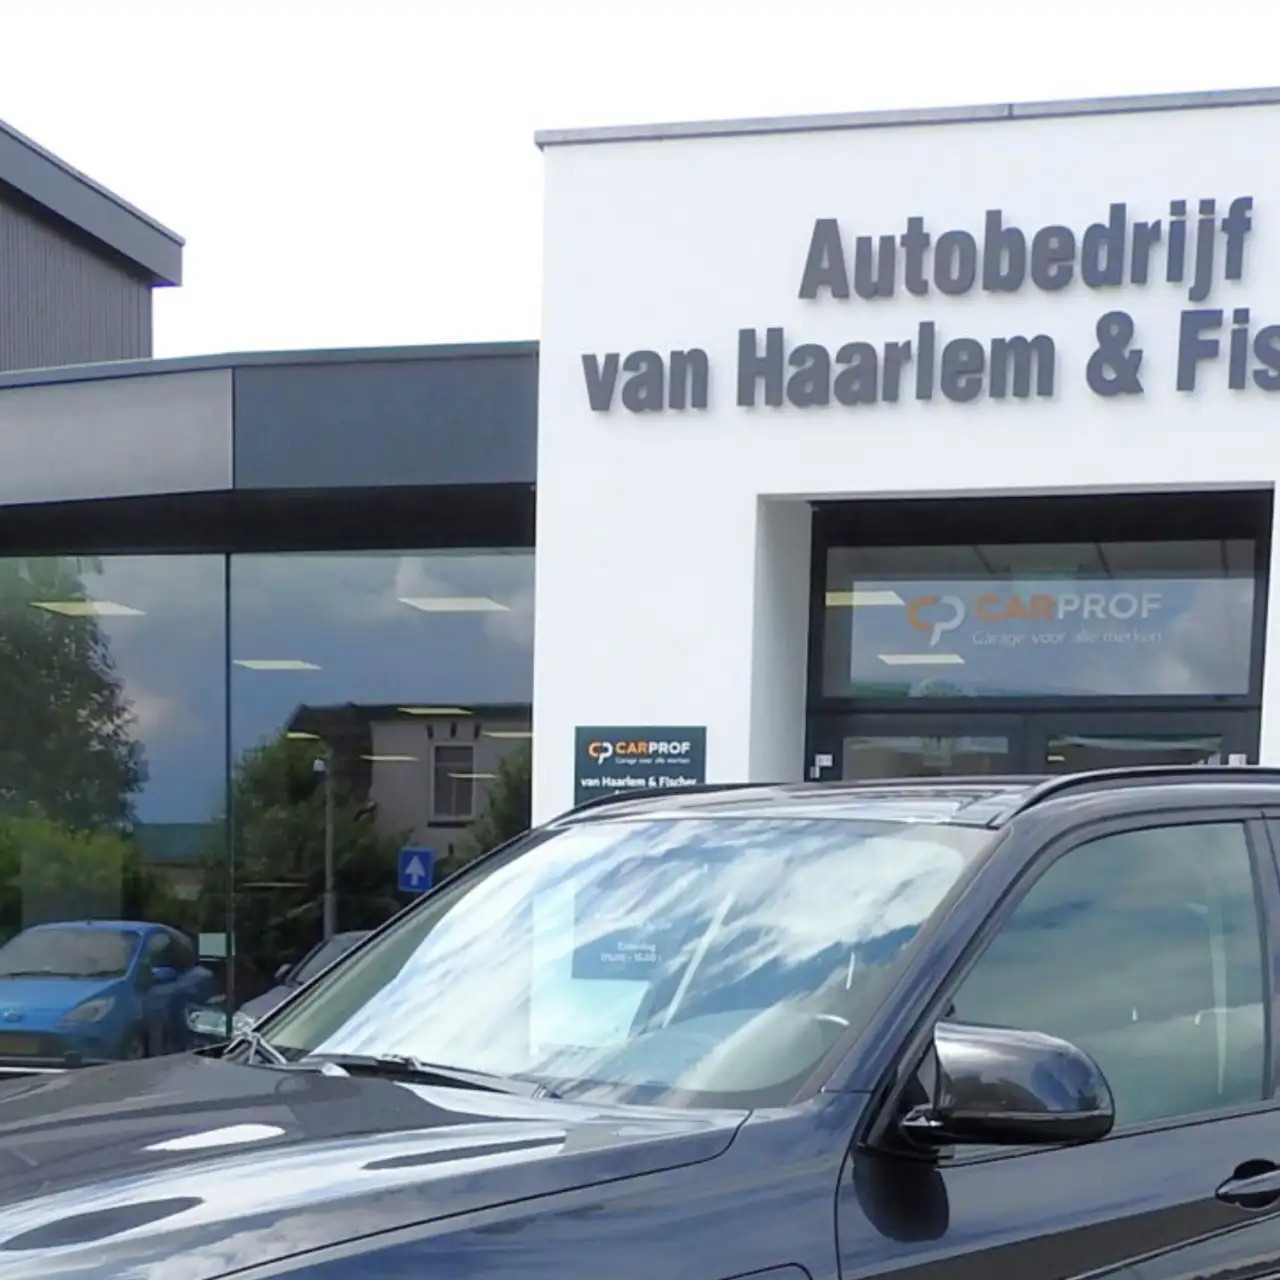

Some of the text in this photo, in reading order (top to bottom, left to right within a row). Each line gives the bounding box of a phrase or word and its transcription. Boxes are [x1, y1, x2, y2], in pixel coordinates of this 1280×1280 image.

[798, 197, 1254, 302] Autobedrijf
[582, 345, 709, 412] van
[737, 322, 1056, 408] Haarlem
[1086, 310, 1144, 397] &
[975, 593, 1162, 620] CARPROF
[972, 629, 1026, 646] Garage
[1032, 631, 1066, 644] voor
[615, 741, 692, 754] CARPROF
[581, 778, 600, 787] van
[602, 776, 646, 787] Haarlem
[659, 776, 697, 788] Fischer
